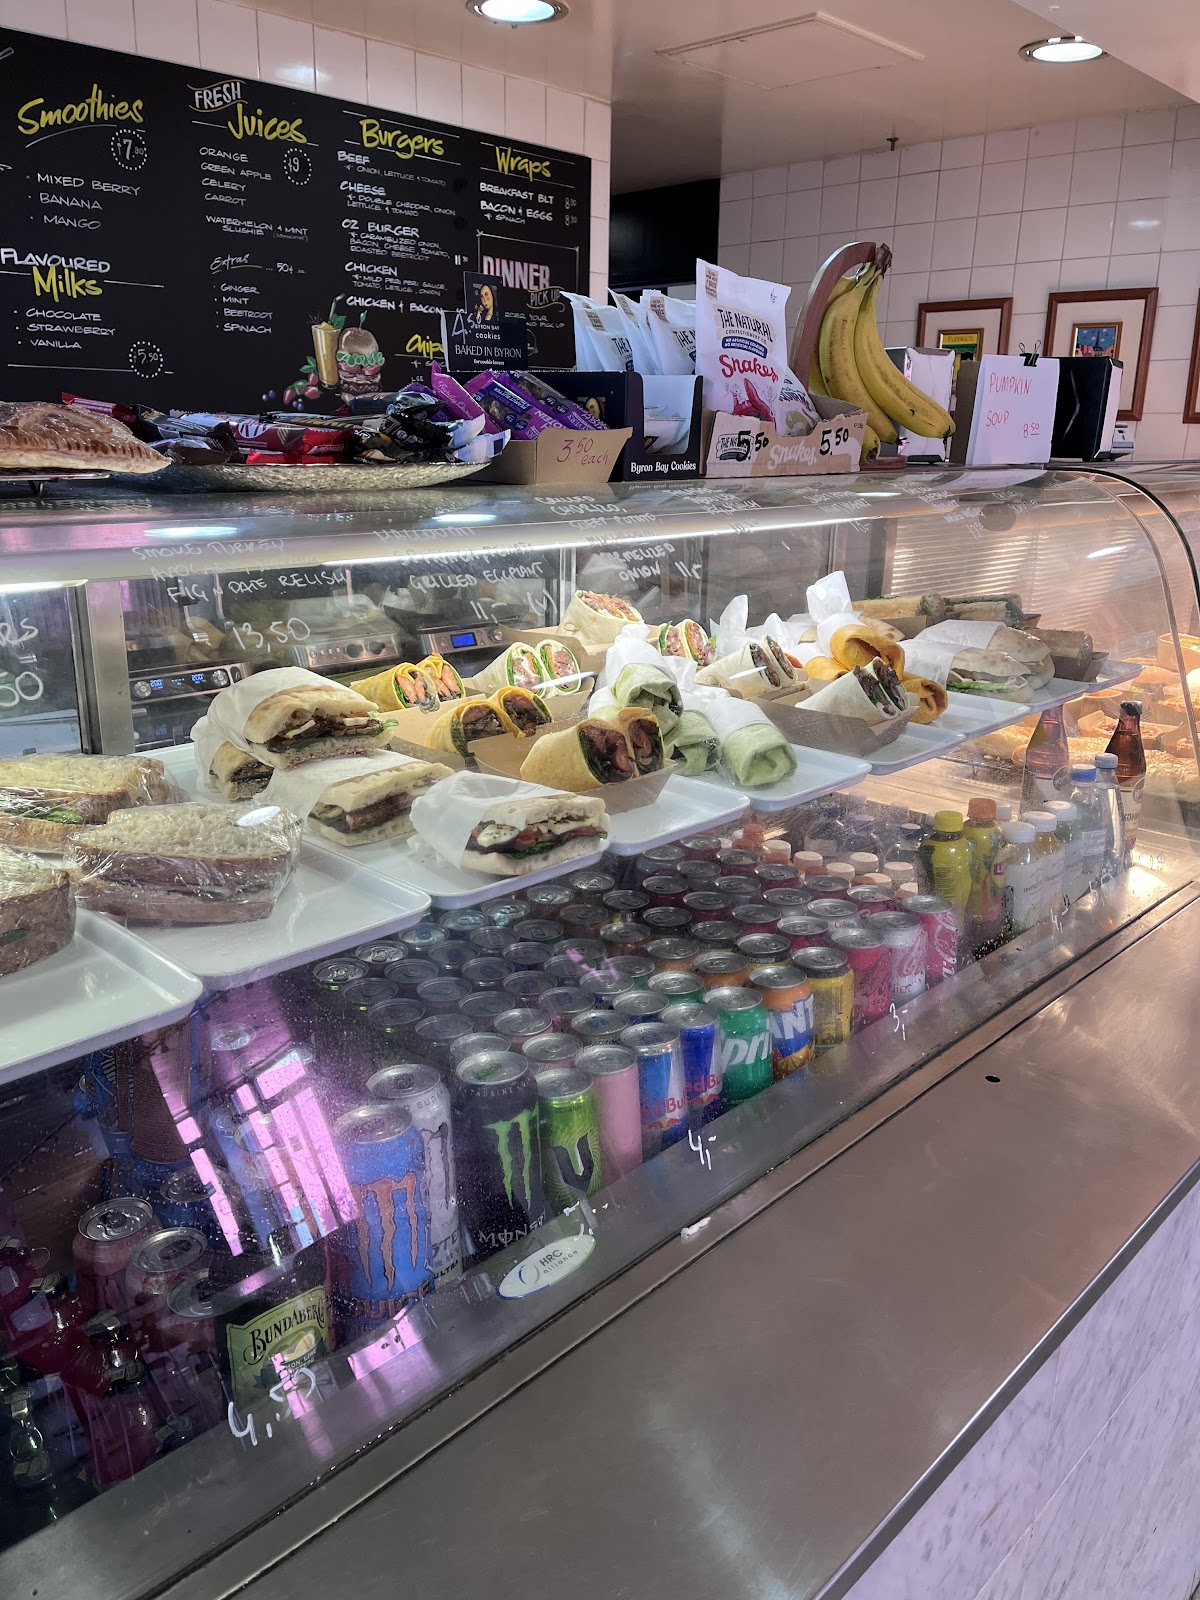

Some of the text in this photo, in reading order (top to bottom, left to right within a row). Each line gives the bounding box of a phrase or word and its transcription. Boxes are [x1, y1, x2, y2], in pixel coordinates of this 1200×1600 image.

[194, 81, 243, 109] FRESH
[17, 83, 144, 135] Smoothies
[227, 102, 308, 144] Juices
[358, 118, 445, 160] Burgers
[199, 146, 249, 163] ORANGE
[337, 150, 371, 166] BEEF
[200, 162, 272, 181] GREEN APPLE
[495, 145, 552, 182] Wraps
[37, 172, 142, 196] MIXED BERRY
[201, 177, 247, 192] CELERY
[383, 170, 416, 181] LETTUCE
[421, 176, 447, 187] TOMATO
[339, 180, 387, 196] CHEESE
[479, 181, 555, 205] BREAKFAST BLT
[39, 192, 103, 211] BANANA
[204, 193, 247, 207] CARROT
[358, 194, 393, 206] DOUBLE
[391, 207, 419, 217] TOMATO
[480, 199, 516, 215] BACON
[526, 208, 554, 222] EGGS
[43, 215, 101, 230] MANGO
[205, 214, 273, 231] WATERMELON
[285, 227, 309, 236] MINT
[222, 225, 265, 236] SLUSHIE
[367, 221, 420, 239] BURGER
[0, 247, 111, 273] FLAVOURED
[210, 253, 250, 270] Extras
[350, 245, 431, 262] ROASTED BEETROOT
[344, 261, 398, 277] CHICKEN
[482, 255, 551, 291] DINNER
[32, 263, 103, 303] Milks
[362, 275, 382, 283] MILD
[220, 283, 260, 295] GINGER
[418, 288, 441, 297] ONION
[222, 296, 250, 306] MINT
[346, 295, 396, 311] CHICKEN
[409, 302, 443, 315] BACON
[530, 291, 548, 306] PICK
[26, 307, 103, 322] CHOCOLATE
[223, 308, 273, 321] BEETROOT
[528, 313, 548, 322] YOUR
[26, 322, 116, 336] STRAWBERRY
[223, 323, 273, 334] SPINACH
[717, 308, 774, 343] THE NATURAL
[475, 331, 501, 340] cookies
[673, 330, 693, 348] THE
[725, 329, 760, 340] CONFECTIONERY
[30, 338, 83, 350] VANILLA
[455, 344, 522, 358] BAKED IN BYRON
[718, 353, 779, 383] Snakes
[989, 371, 1033, 395] PUMPKIN
[985, 410, 1010, 428] SOUP
[581, 452, 609, 466] each
[767, 440, 817, 471] Snakes
[630, 460, 697, 475] Byron Bay Cookies
[408, 561, 544, 594] GRILLED EGGPLANT
[618, 560, 662, 583] ONION
[166, 583, 210, 603] FIG
[227, 577, 268, 595] DATE
[277, 570, 349, 588] RELISH
[539, 1249, 563, 1267] HRC
[542, 1249, 579, 1275] alliance
[243, 1296, 327, 1366] BUNDABERG
